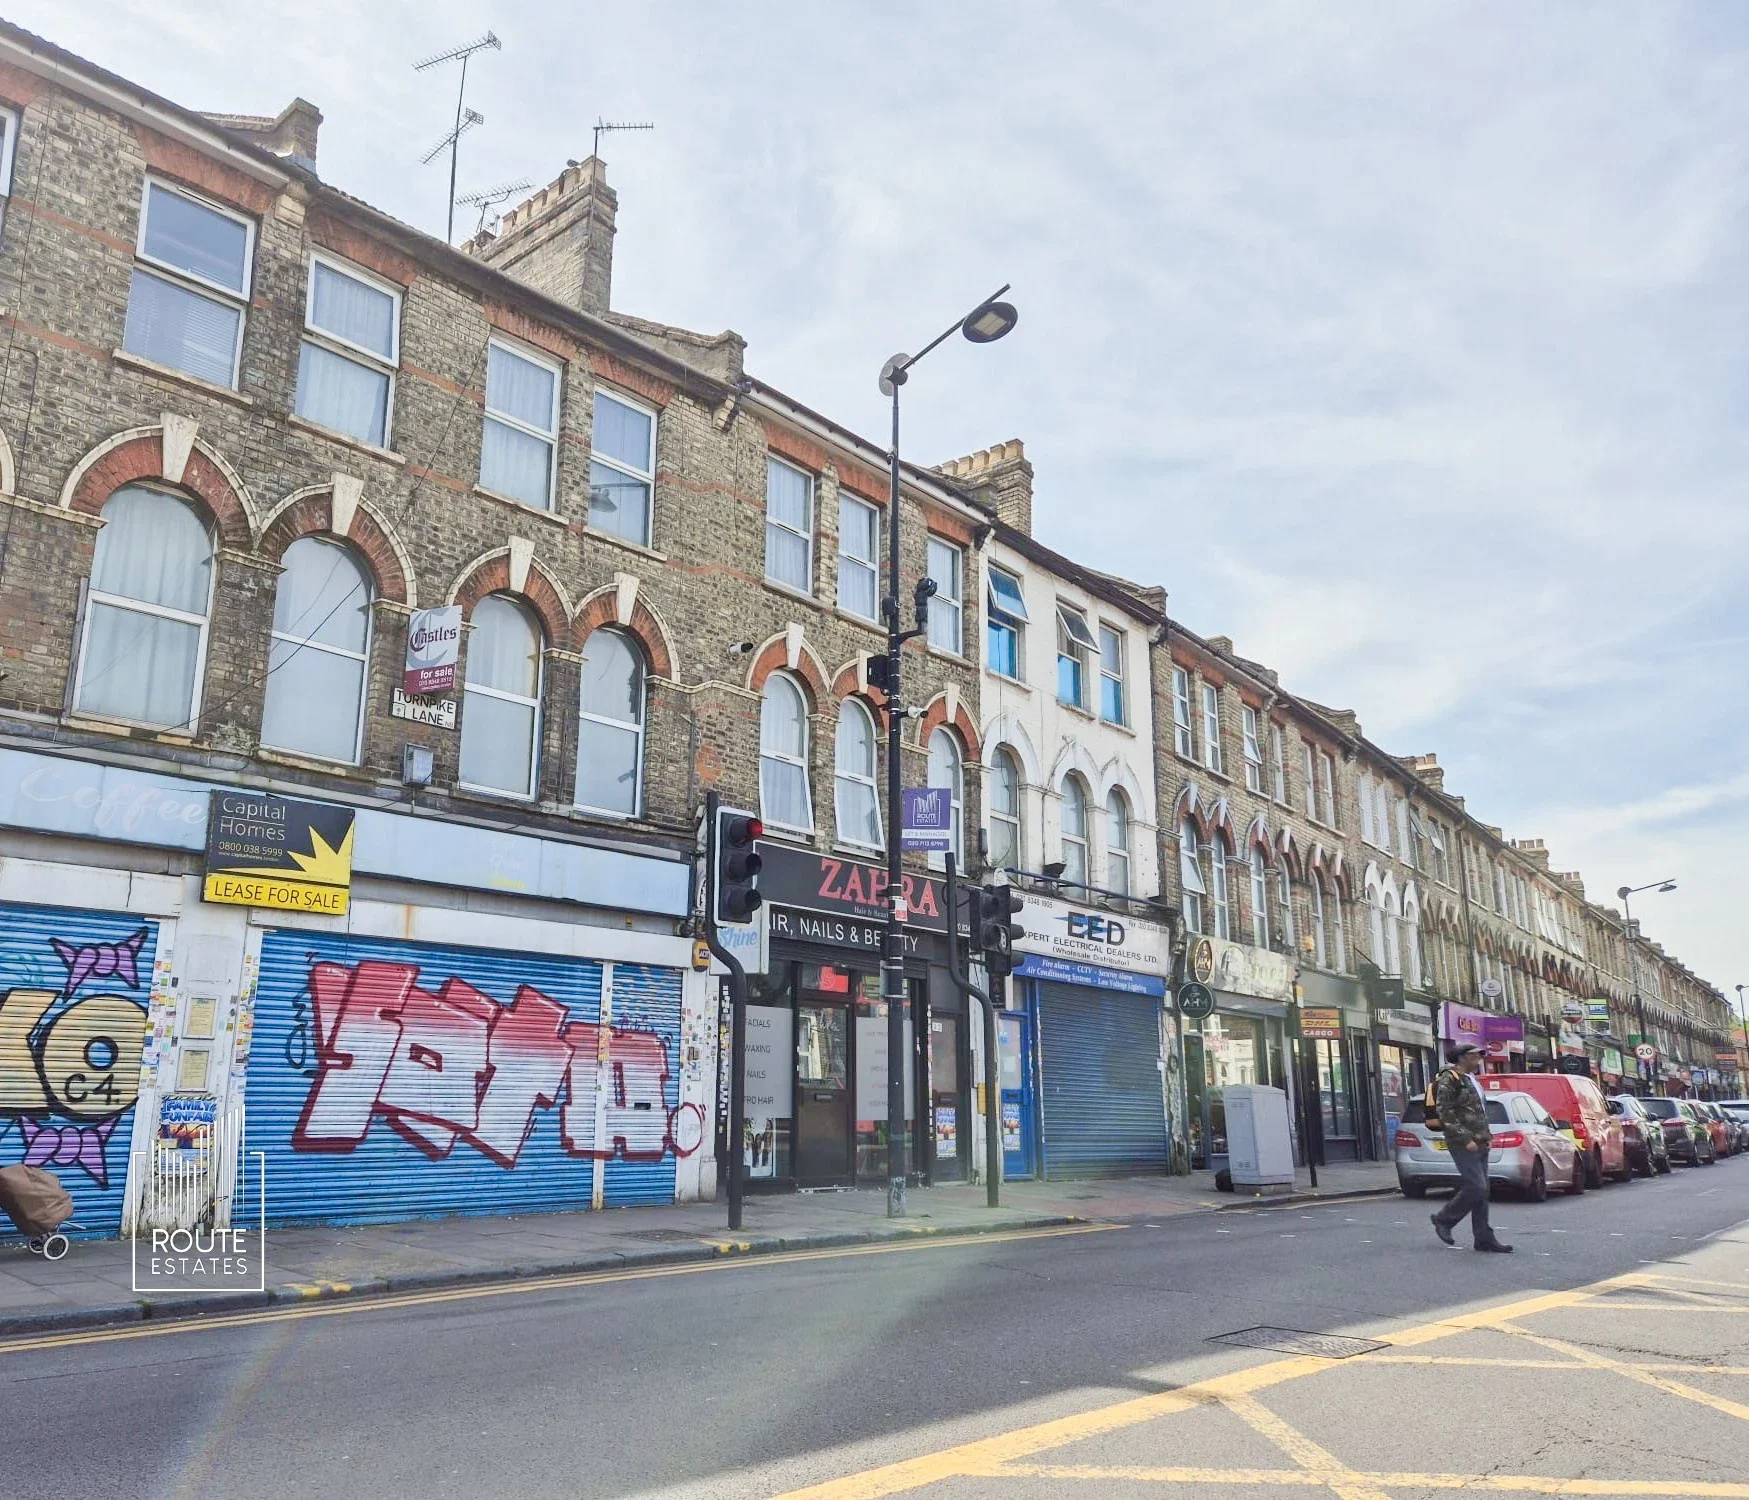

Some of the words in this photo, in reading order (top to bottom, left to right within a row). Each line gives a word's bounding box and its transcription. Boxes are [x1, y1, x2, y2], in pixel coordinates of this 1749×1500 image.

[420, 669, 433, 680] for
[434, 666, 453, 678] sale
[397, 689, 454, 714] TURNPIKE
[412, 707, 445, 726] LANE
[20, 766, 207, 833] Coffee
[222, 797, 286, 820] Capital
[220, 818, 285, 840] Homes
[219, 841, 242, 852] 0800
[243, 844, 260, 854] 038
[214, 881, 264, 901] LEASE
[267, 887, 300, 905] FOR
[303, 891, 341, 909] SALE
[719, 926, 758, 949] Shine
[769, 914, 794, 935] IR,
[800, 919, 845, 940] NAILS
[850, 926, 859, 943] &
[864, 928, 918, 952] BETY
[1067, 911, 1126, 946] EED
[1024, 930, 1050, 943] XPERT
[1053, 937, 1103, 954] ELECTRICAL
[1106, 947, 1142, 961] DEALERS
[747, 1018, 771, 1028] ACIALS
[1638, 1047, 1653, 1056] 20
[165, 1099, 212, 1112] FAMILY
[161, 1111, 215, 1124] FUNFAIR
